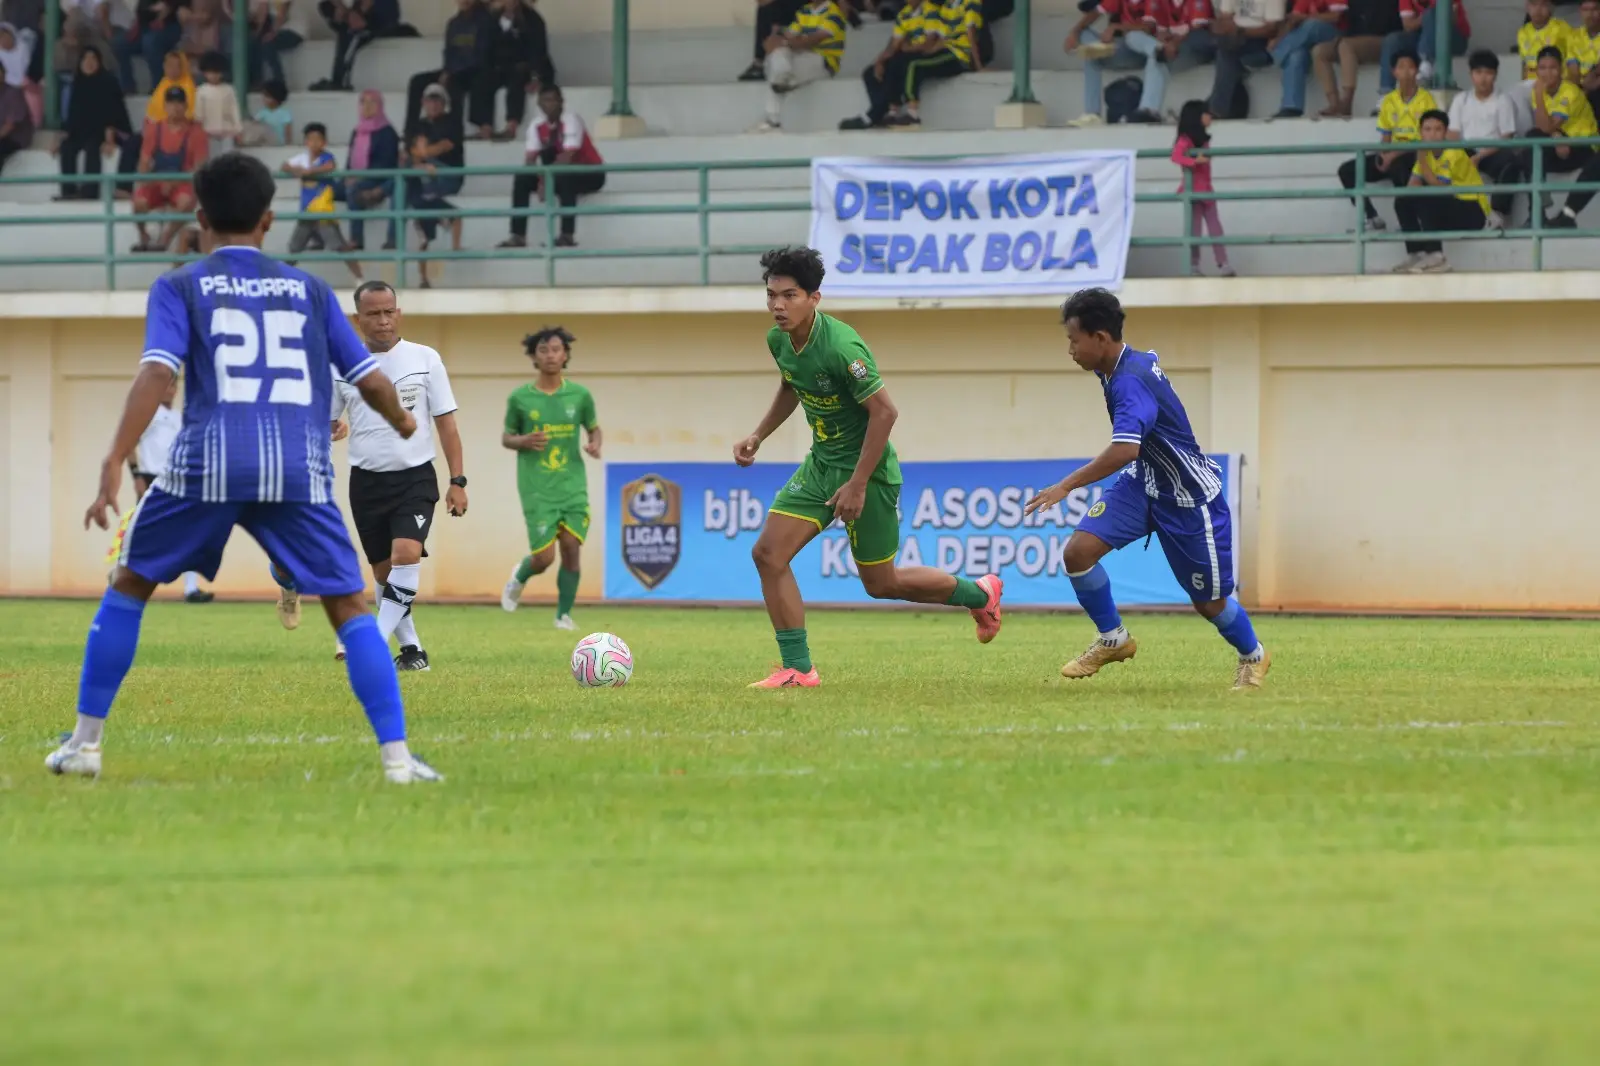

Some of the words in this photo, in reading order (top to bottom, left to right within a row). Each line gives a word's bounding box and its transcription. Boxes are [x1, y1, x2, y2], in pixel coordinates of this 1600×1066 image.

[835, 179, 979, 221] DEPOK
[988, 174, 1099, 219] KOTA
[835, 233, 975, 274] SEPAK
[981, 228, 1098, 272] BOLA
[210, 307, 312, 406] 25
[704, 488, 764, 538] bjb
[912, 486, 1103, 529] ASOSIASI
[625, 526, 664, 545] LIGA
[821, 535, 925, 578] KA
[937, 535, 1070, 578] DEPOK
